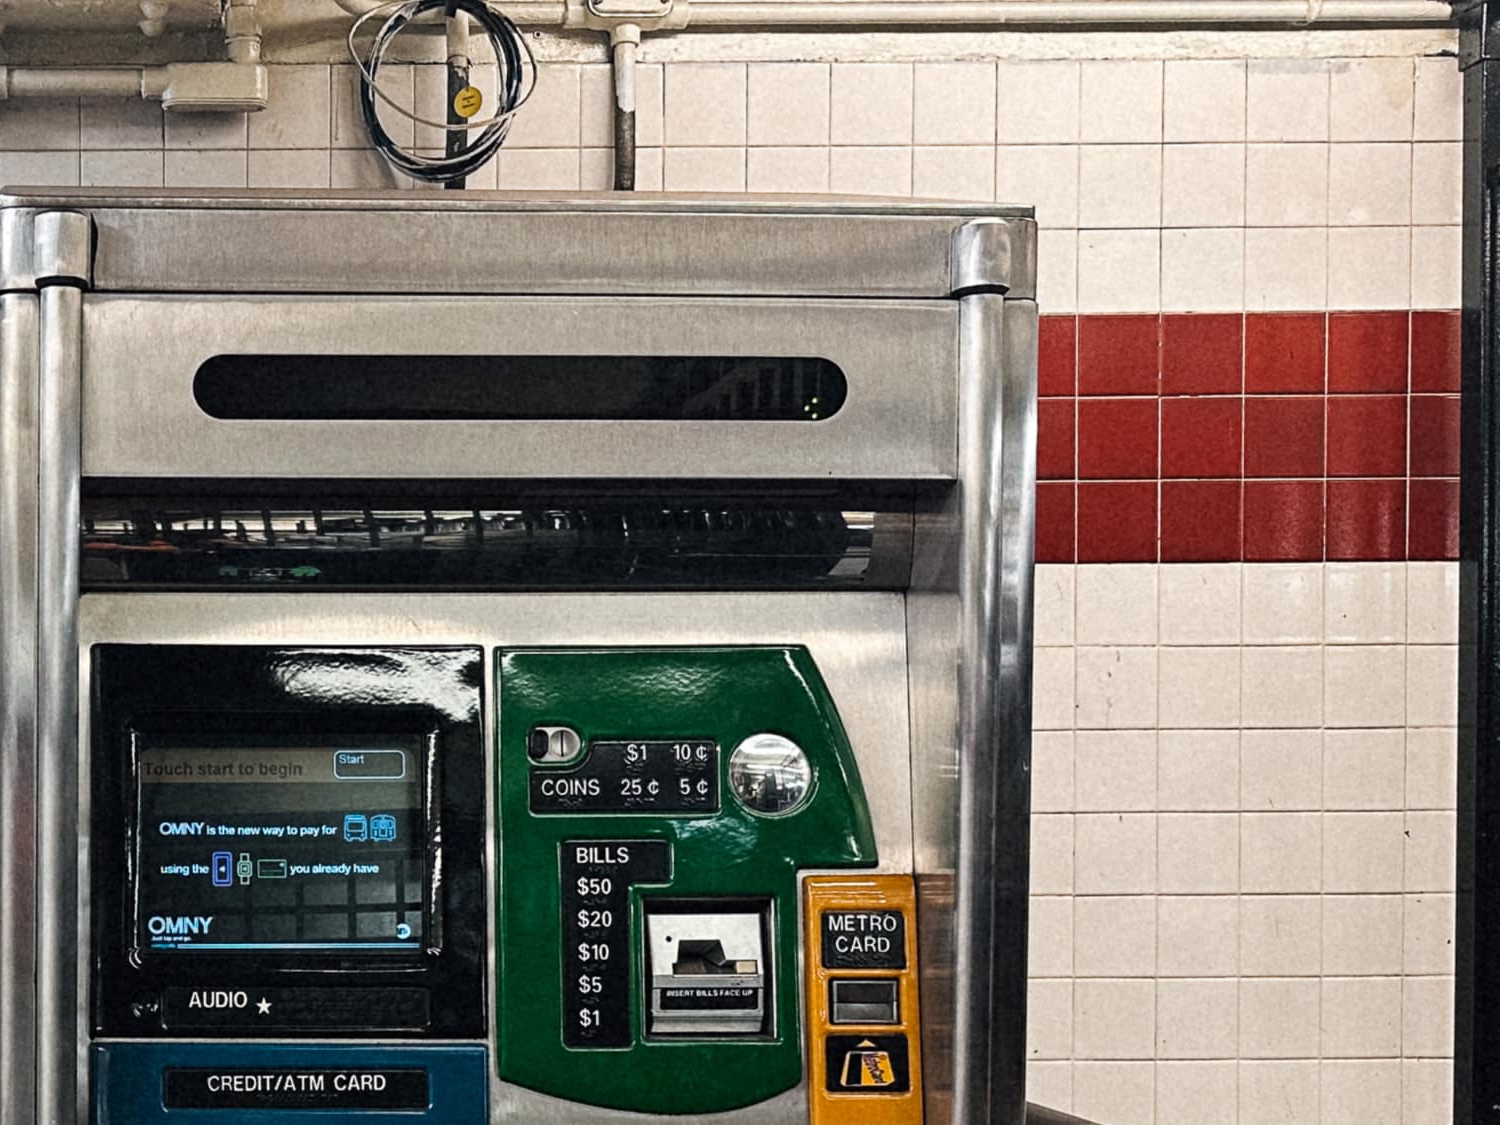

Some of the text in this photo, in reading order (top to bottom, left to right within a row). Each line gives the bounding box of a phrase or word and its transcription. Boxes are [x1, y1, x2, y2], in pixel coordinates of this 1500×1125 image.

[338, 754, 365, 765] Start
[627, 744, 647, 762] $1
[145, 762, 303, 779] Touch start to begin
[541, 779, 600, 796] COINS
[159, 822, 338, 838] OMNY is the new way to pay for
[576, 847, 629, 864] BILLS
[160, 864, 209, 876] using the
[289, 864, 380, 876] you already have
[577, 878, 611, 896] $50
[148, 916, 213, 934] OMNY
[577, 911, 612, 928] $20
[829, 914, 897, 932] METRO
[578, 943, 609, 961] $10
[835, 935, 890, 953] CARD
[578, 976, 602, 994] $5
[188, 992, 248, 1008] AUDIO
[579, 1009, 601, 1028] $1
[207, 1074, 386, 1092] CREDIT/ATM CARD
